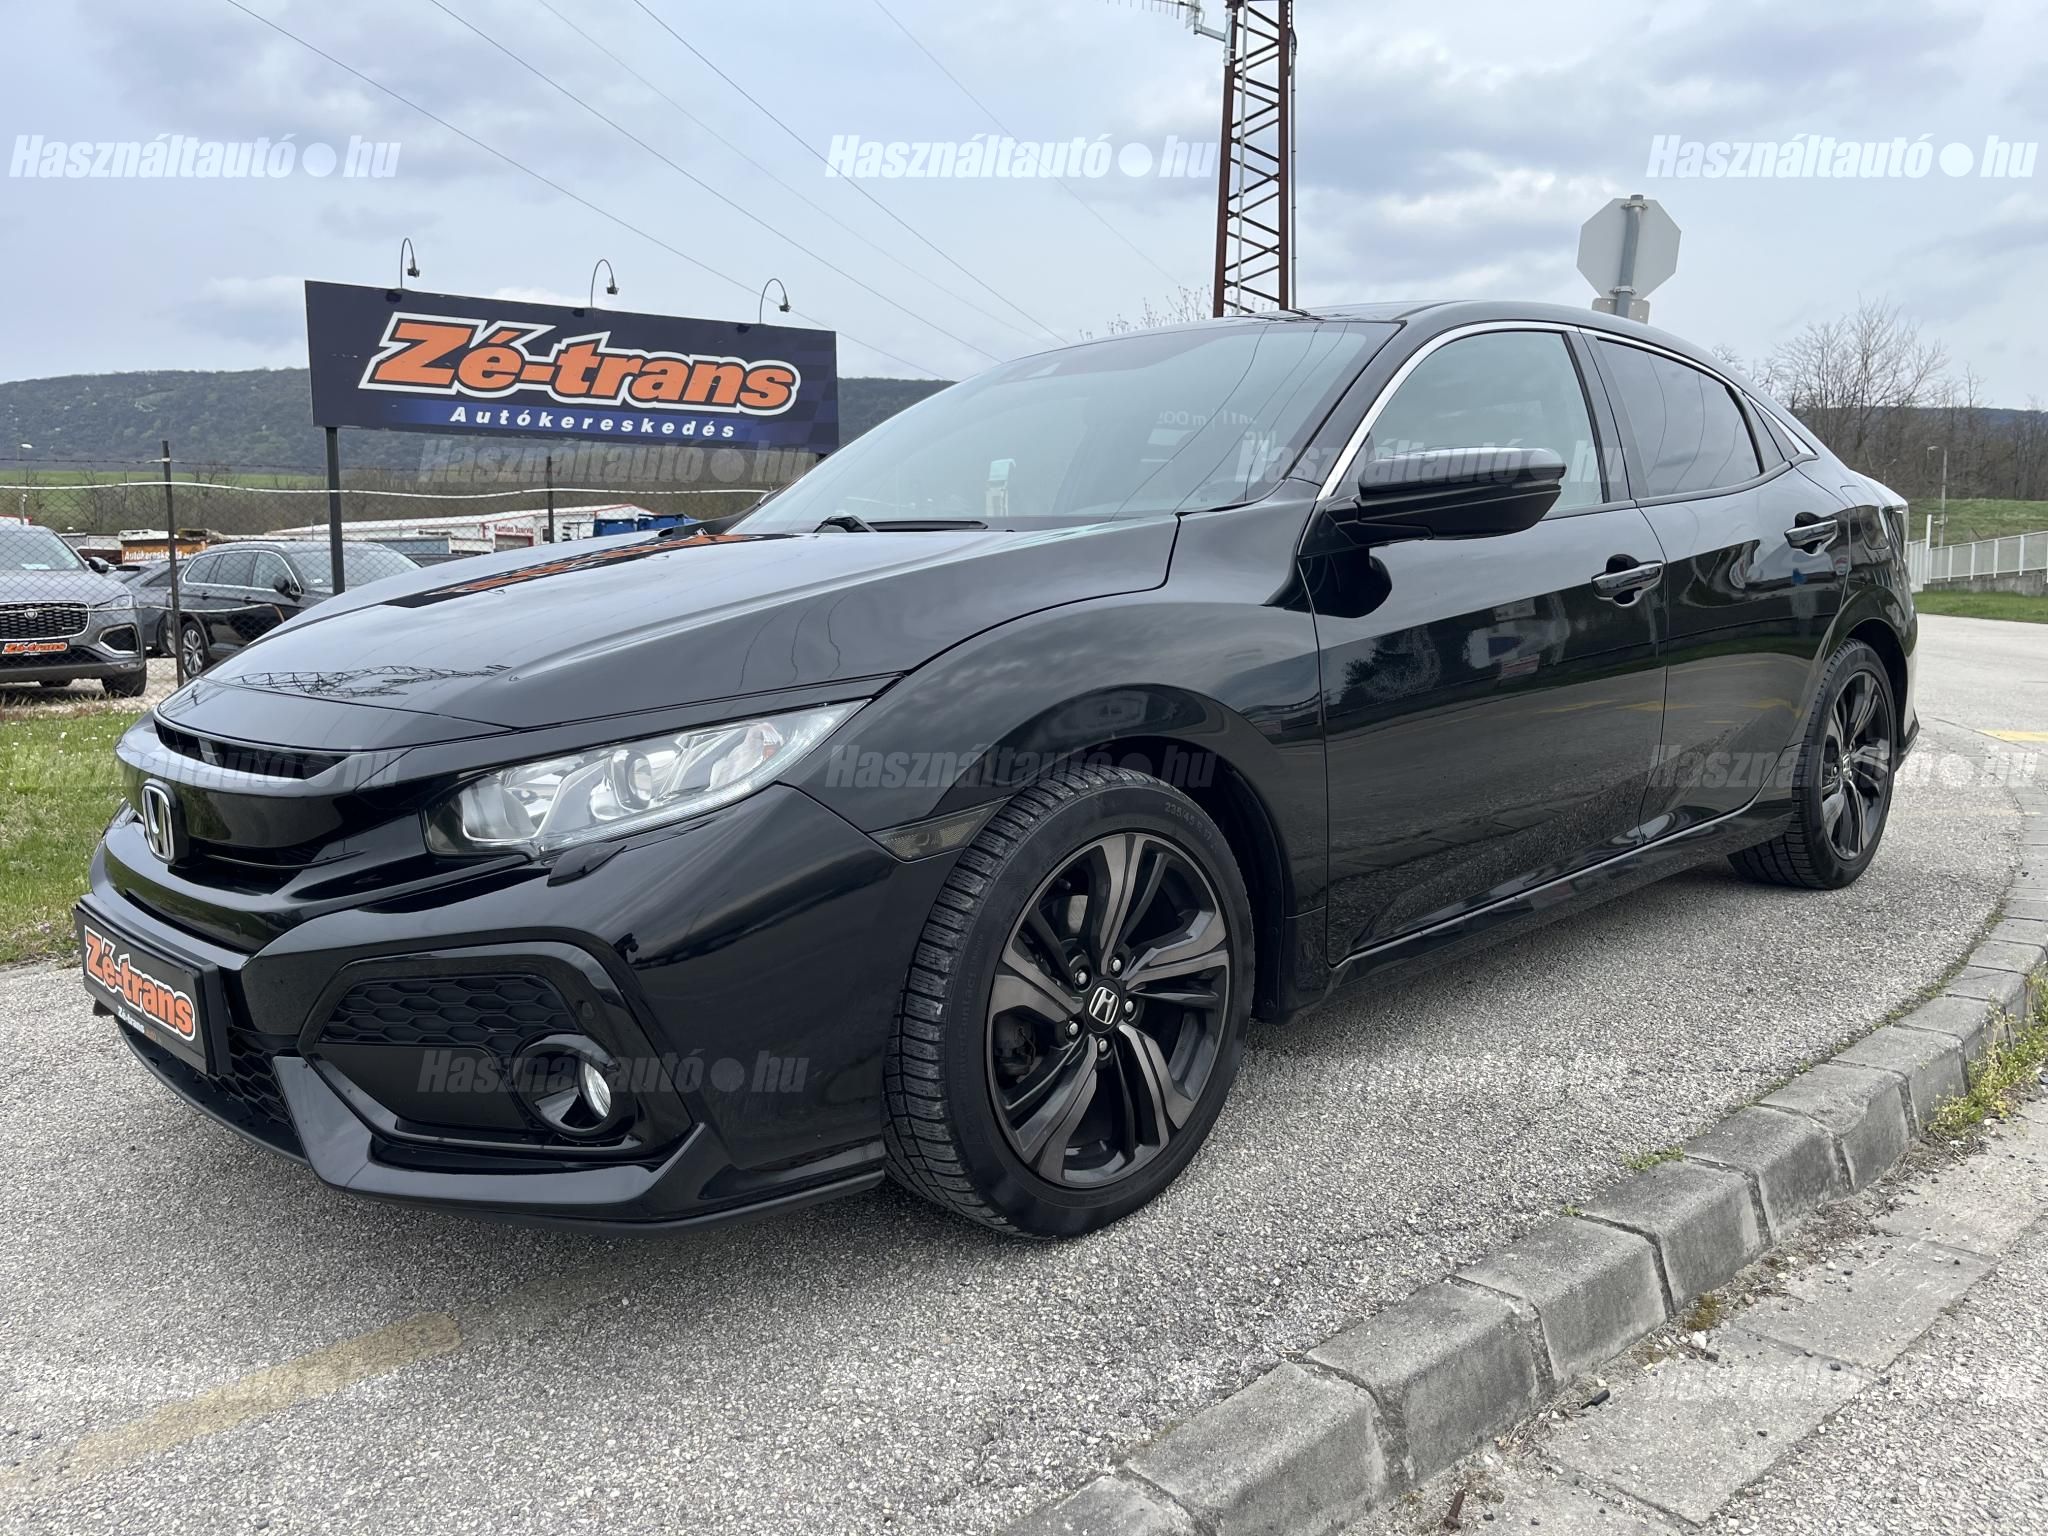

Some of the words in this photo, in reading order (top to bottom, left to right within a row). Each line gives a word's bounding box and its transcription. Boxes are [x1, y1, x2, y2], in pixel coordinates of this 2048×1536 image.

[366, 316, 797, 410] Zé-trans
[450, 405, 737, 439] Autókereskedés
[86, 929, 194, 1037] Zé-trans
